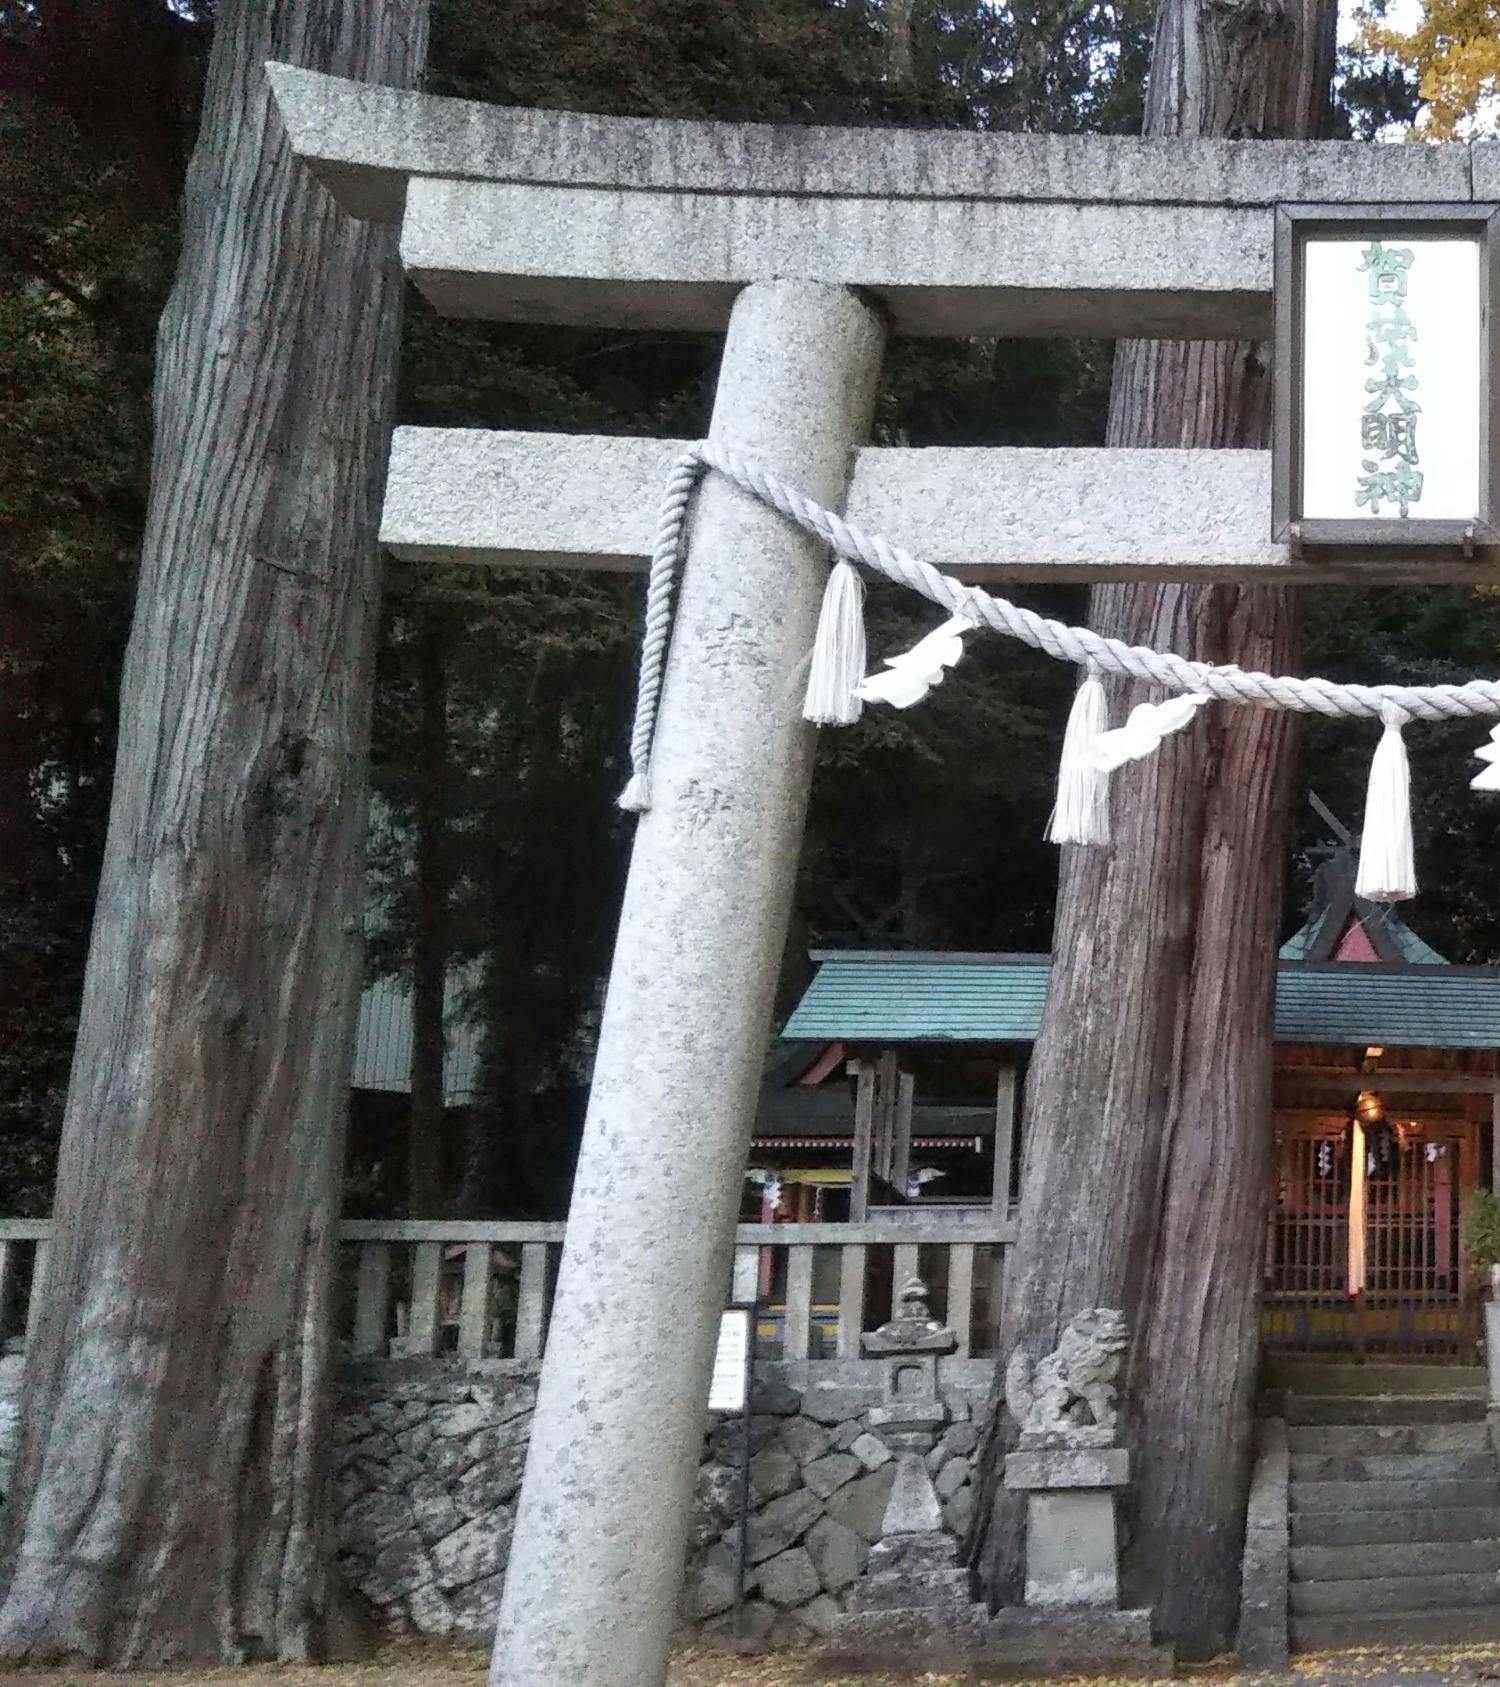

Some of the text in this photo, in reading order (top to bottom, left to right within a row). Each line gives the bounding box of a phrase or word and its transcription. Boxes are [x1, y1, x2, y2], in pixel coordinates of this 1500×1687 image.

[1354, 241, 1425, 518] 賀茂大明神
